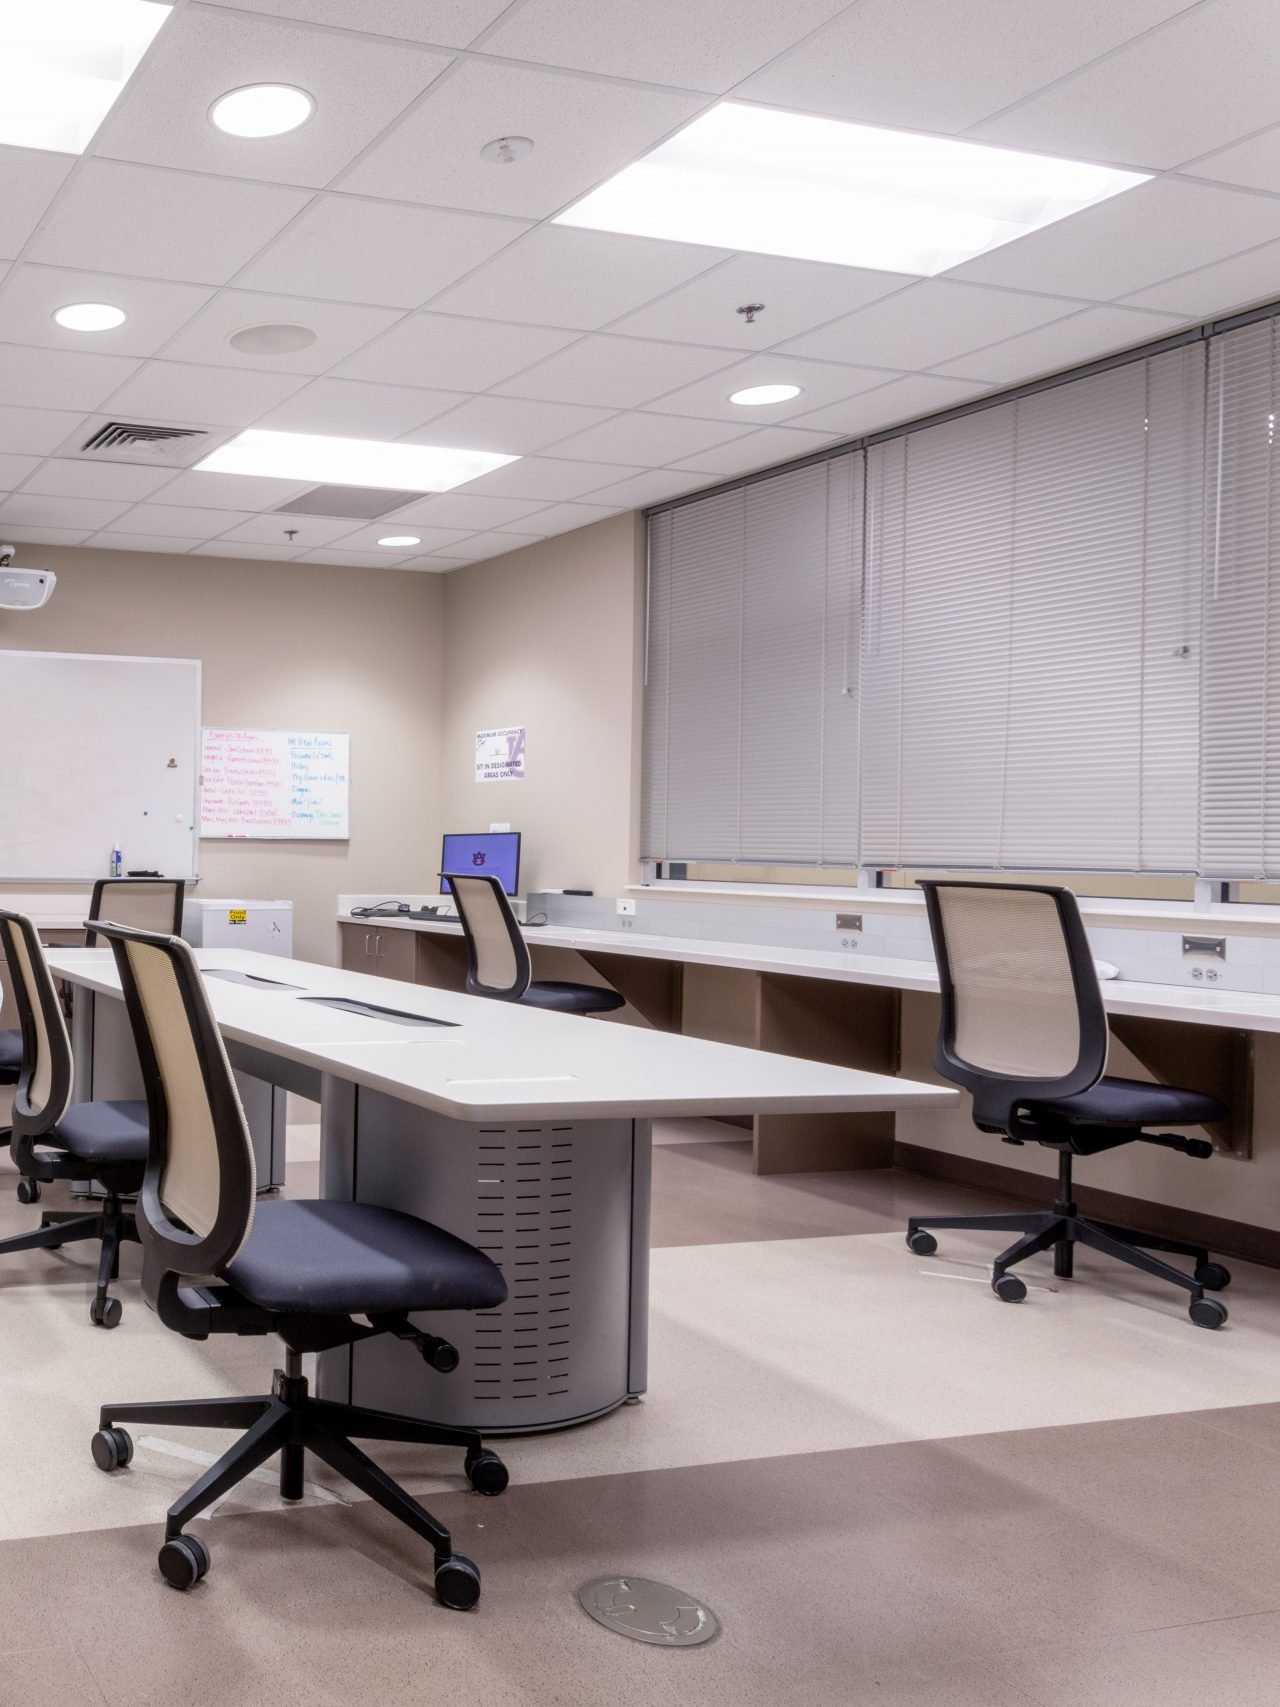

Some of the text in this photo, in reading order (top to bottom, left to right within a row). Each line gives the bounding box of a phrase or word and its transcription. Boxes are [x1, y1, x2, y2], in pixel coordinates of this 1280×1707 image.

[497, 728, 522, 737] OCCUPANCY
[490, 760, 522, 769] DESIGNATED
[499, 770, 514, 778] ONLY
